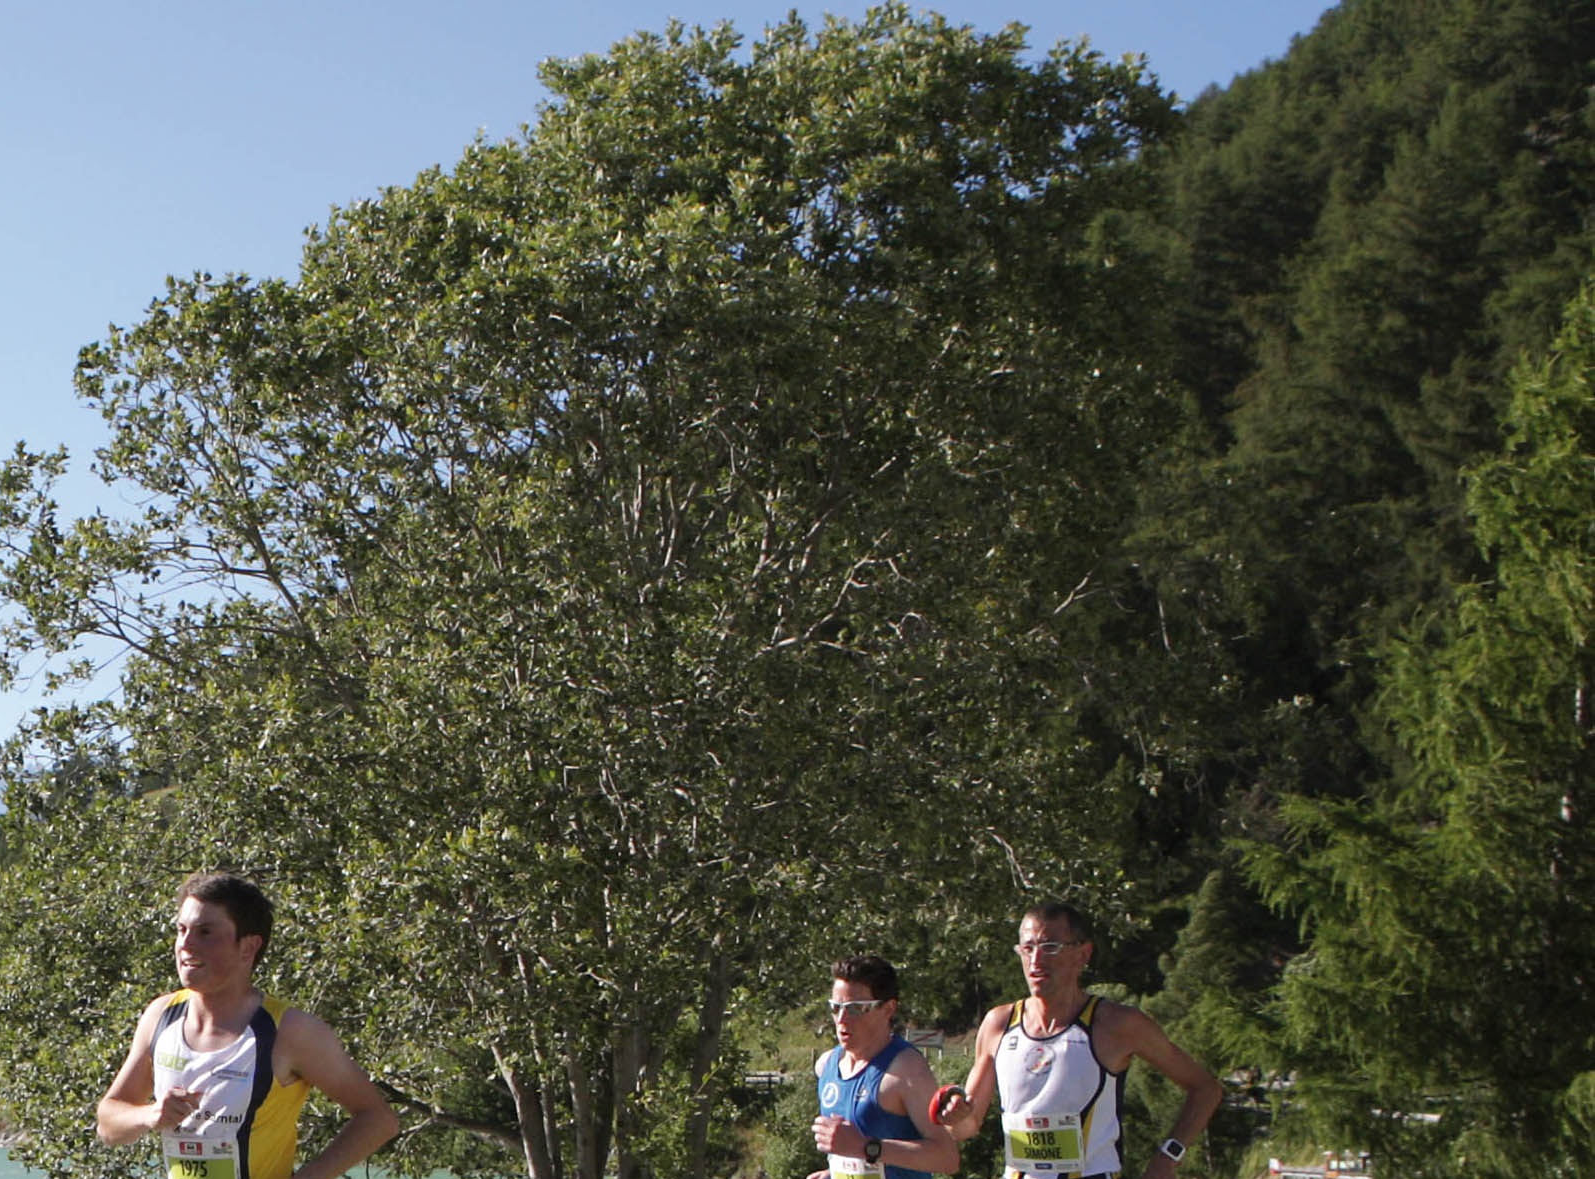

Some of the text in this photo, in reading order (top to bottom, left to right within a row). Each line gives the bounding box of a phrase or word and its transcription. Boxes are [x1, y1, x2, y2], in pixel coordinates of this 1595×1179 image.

[1025, 1131, 1055, 1146] 1818
[1023, 1146, 1062, 1160] SIMONE
[179, 1160, 208, 1177] 1975
